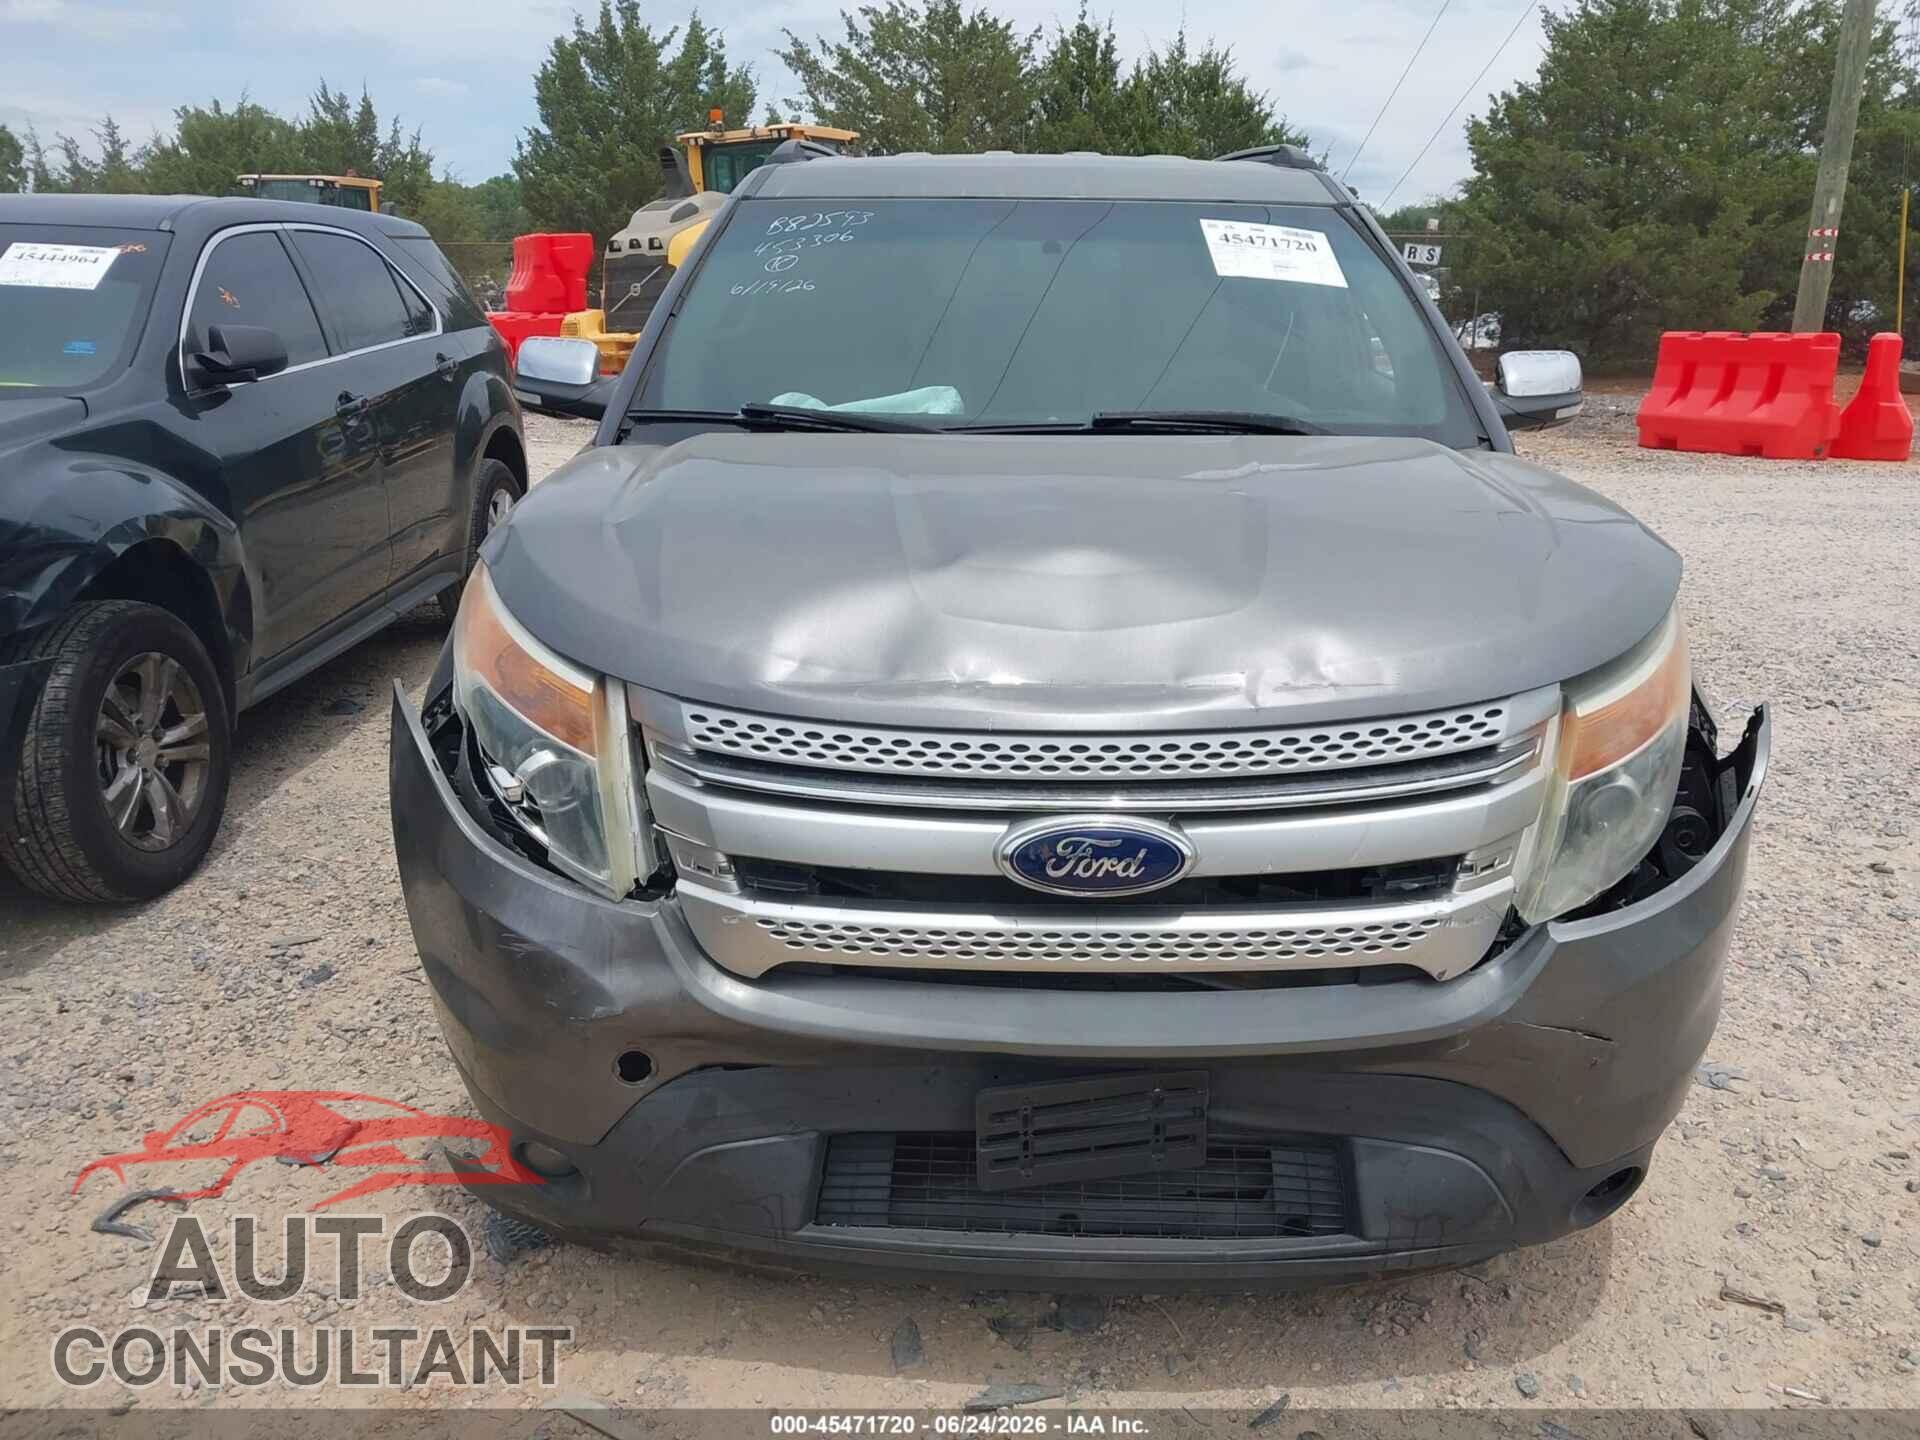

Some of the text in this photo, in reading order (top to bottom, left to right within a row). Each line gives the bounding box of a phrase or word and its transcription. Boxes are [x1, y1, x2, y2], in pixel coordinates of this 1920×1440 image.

[754, 230, 854, 256] 453306
[1218, 232, 1318, 253] 45471720
[14, 251, 100, 265] 45444964
[1045, 836, 1149, 878] Ford
